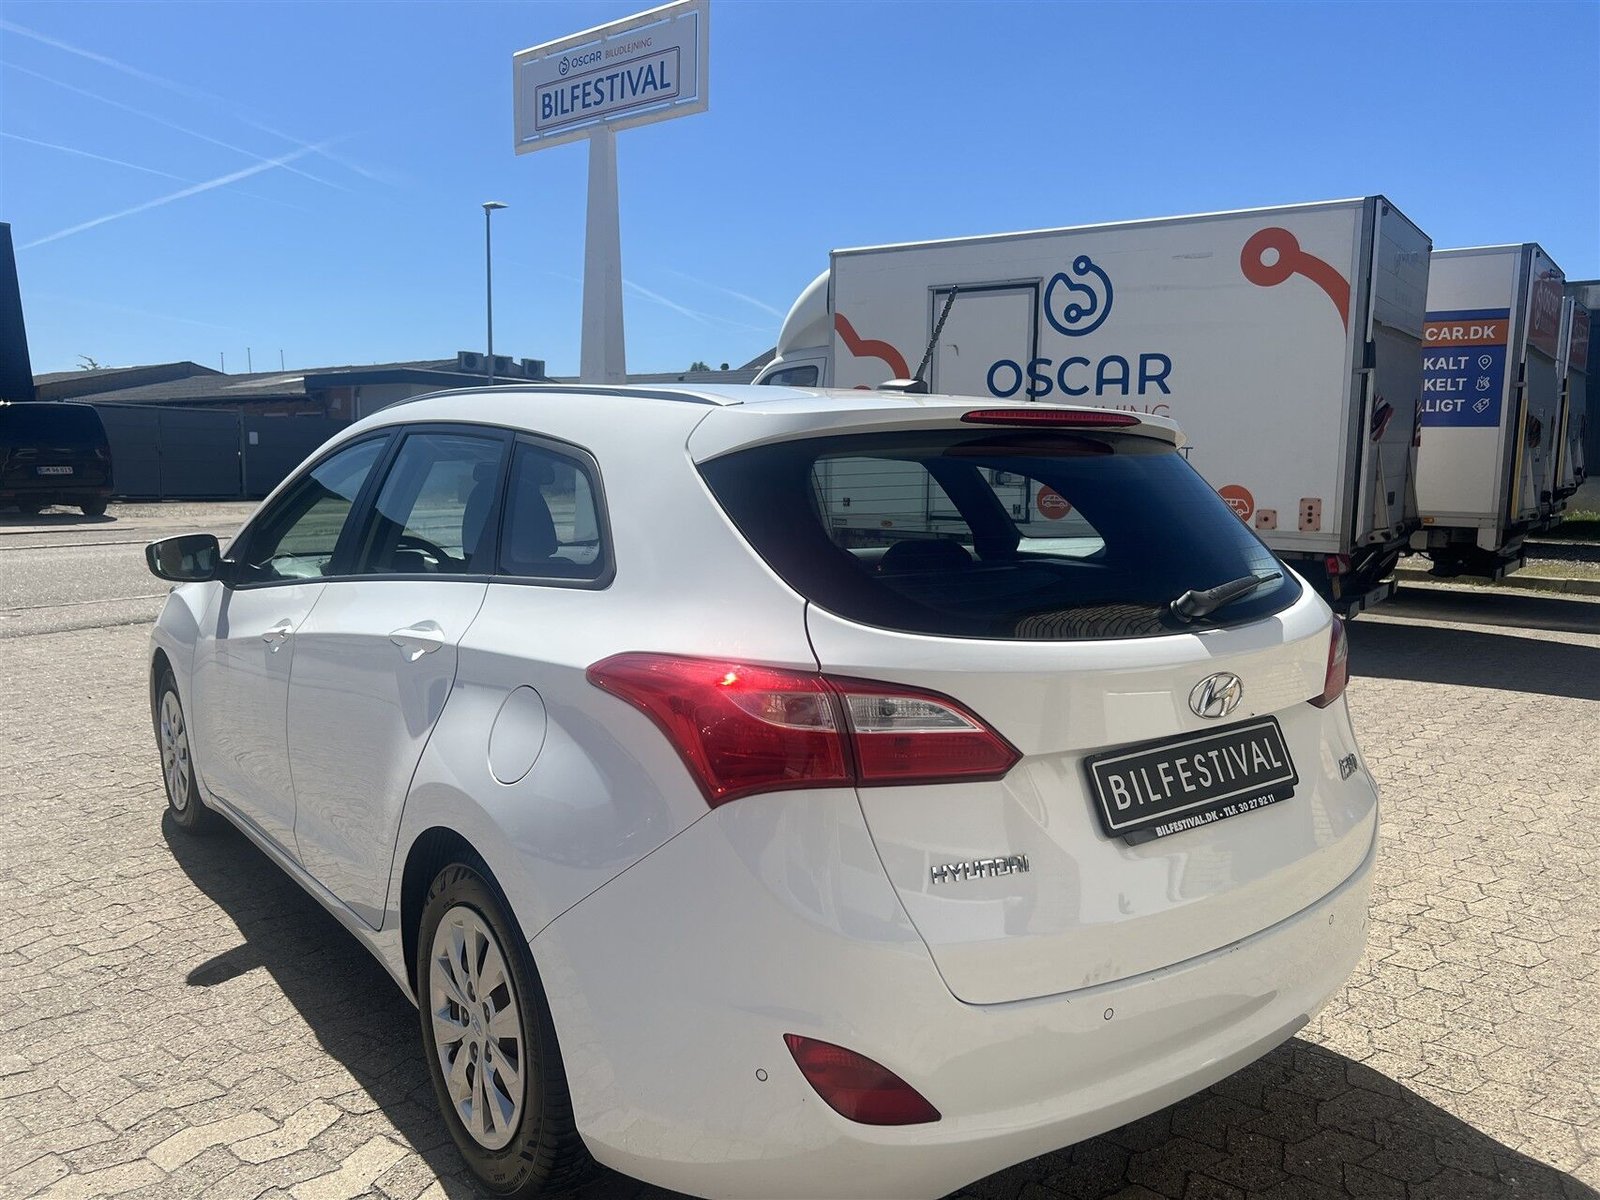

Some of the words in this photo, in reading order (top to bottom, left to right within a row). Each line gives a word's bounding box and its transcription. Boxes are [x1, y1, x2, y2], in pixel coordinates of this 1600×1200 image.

[571, 50, 602, 68] OSCAR
[605, 38, 653, 59] BILUDLEJNING
[541, 60, 671, 120] BILFESTIVAL
[1425, 325, 1497, 341] CAR.DK
[986, 353, 1172, 398] OSCAR
[1423, 356, 1469, 371] KALT
[1424, 378, 1467, 391] KELT
[1421, 399, 1465, 413] LIGT
[1107, 737, 1282, 811] BILFESTIVAL
[1155, 810, 1218, 837] BILFESTIVAL.DK
[1239, 801, 1249, 812] 30
[1249, 799, 1258, 810] 27
[1258, 796, 1267, 807] 92
[1268, 793, 1276, 803] 11
[930, 854, 1030, 884] HYUNDAI
